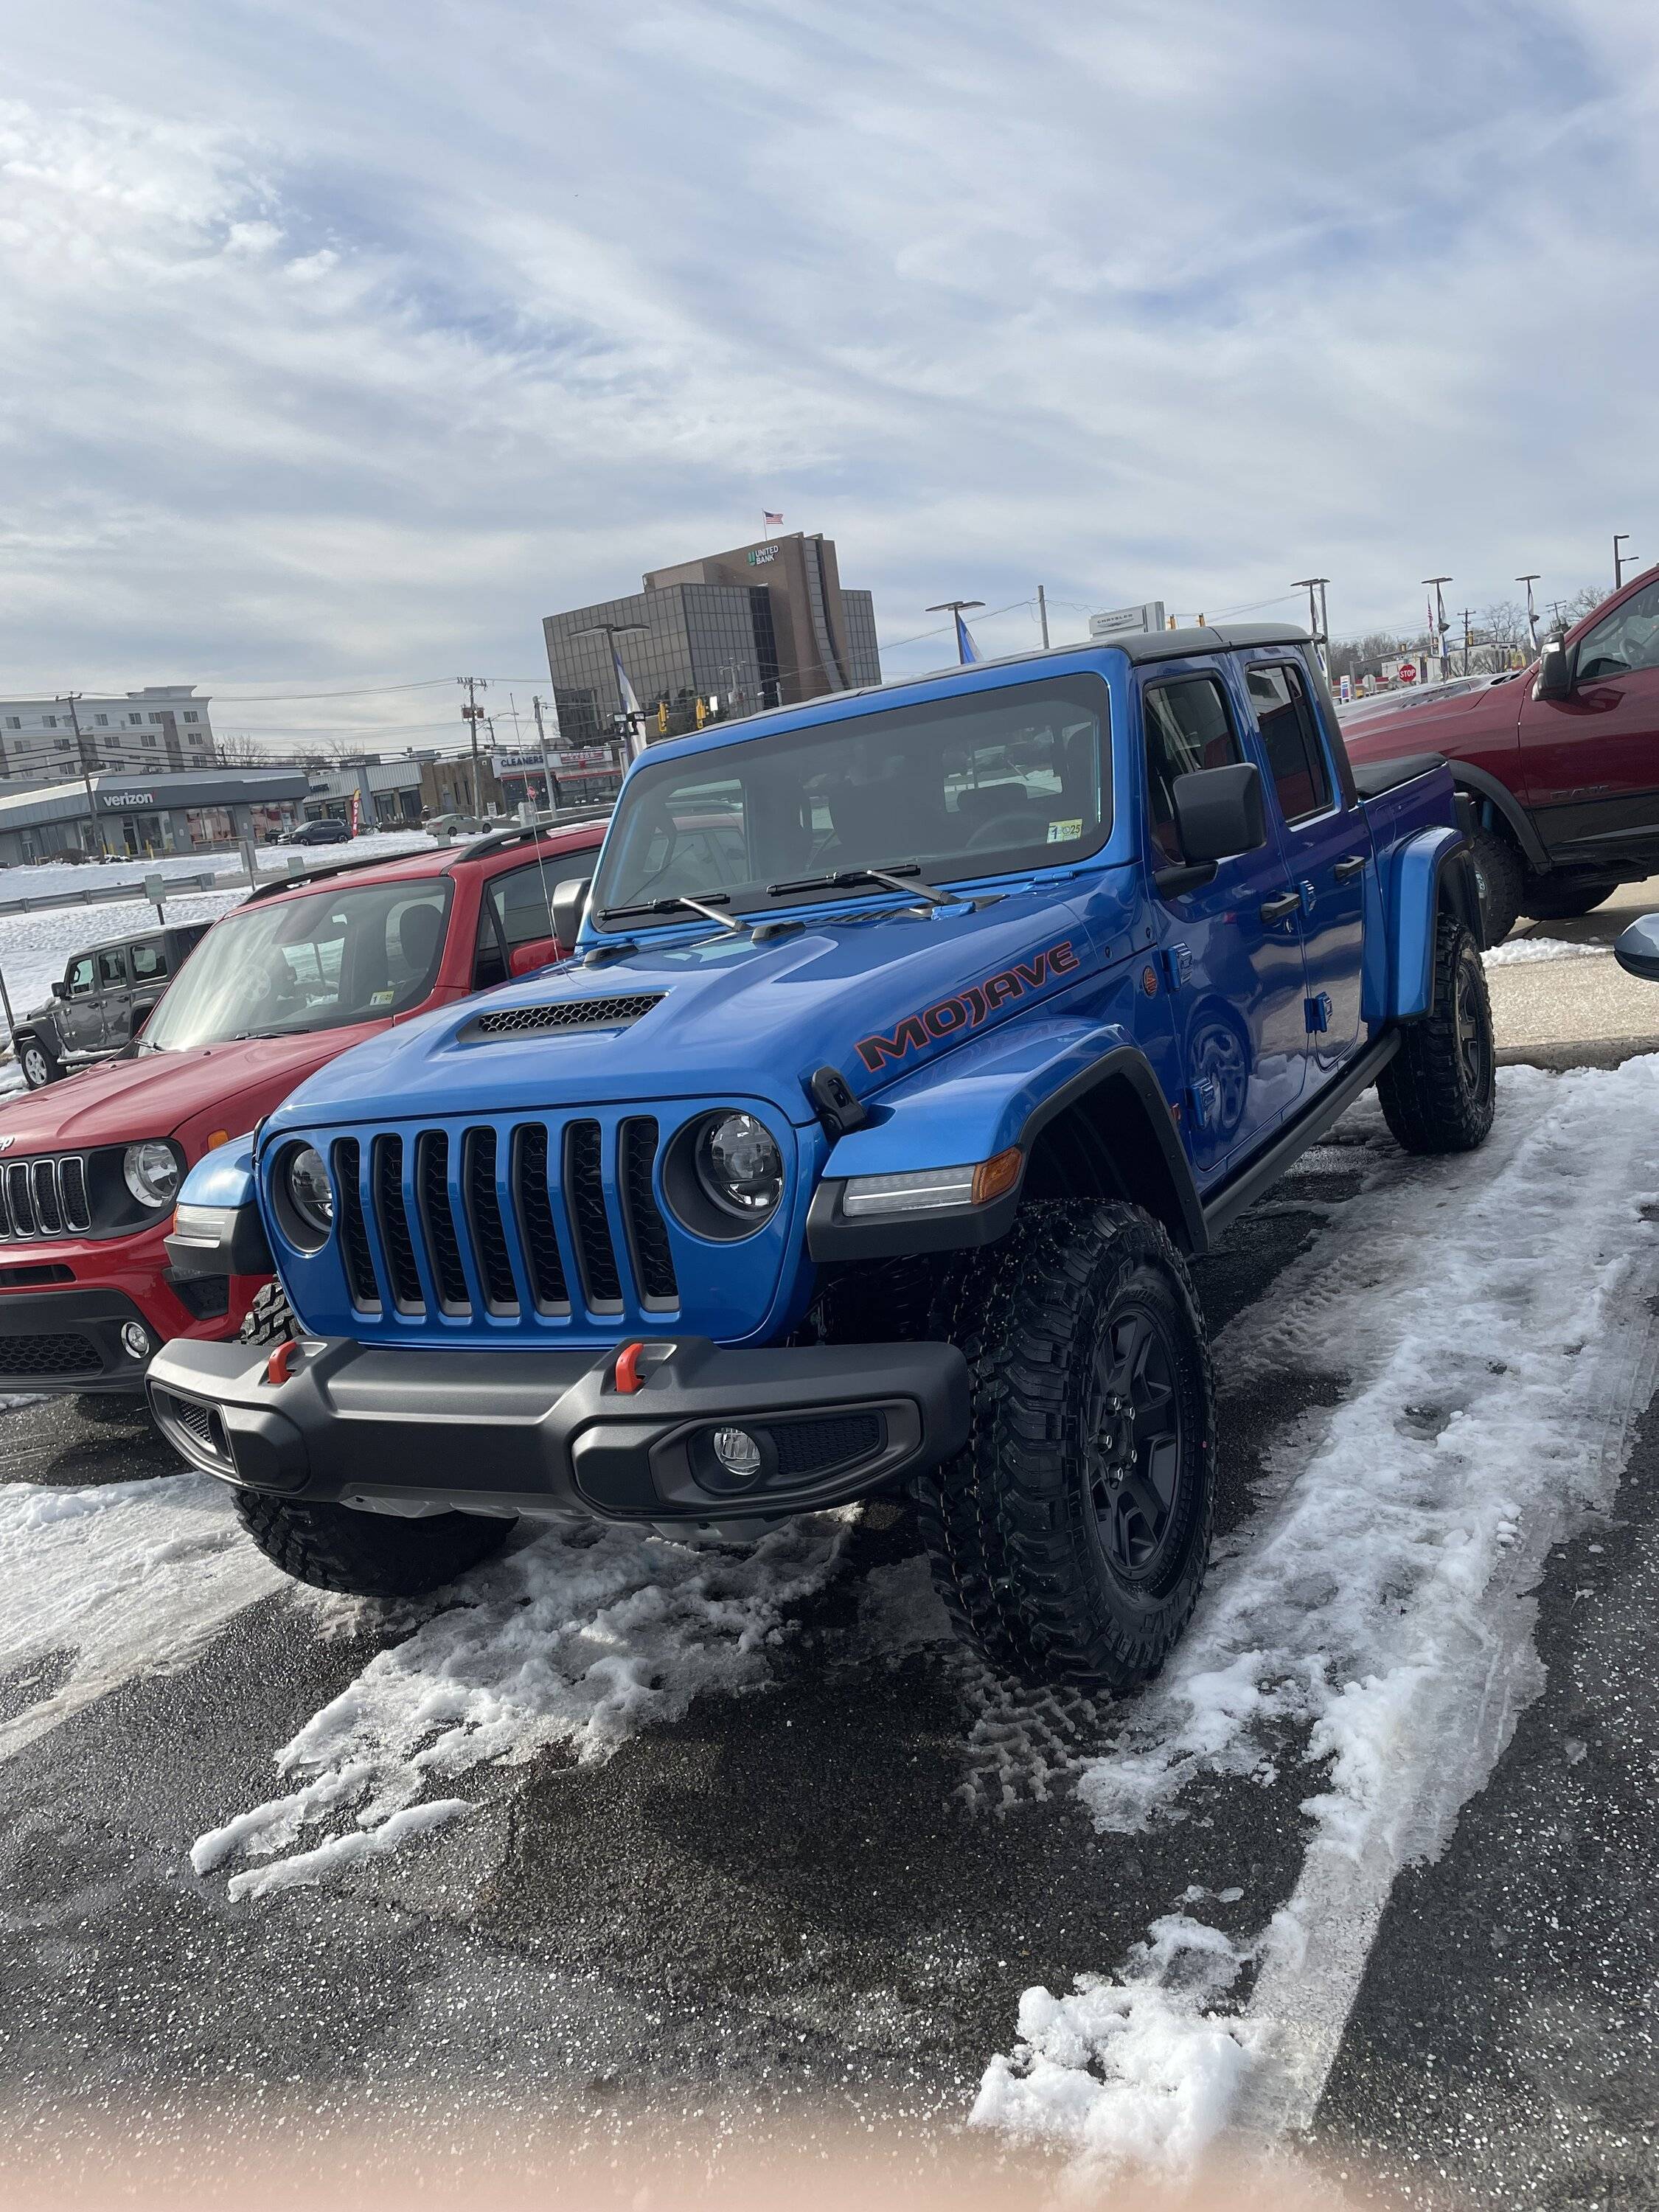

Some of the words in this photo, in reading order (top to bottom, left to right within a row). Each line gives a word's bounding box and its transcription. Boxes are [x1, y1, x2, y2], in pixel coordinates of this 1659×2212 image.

[755, 546, 779, 557] UNITED
[756, 554, 775, 565] BANK
[1097, 613, 1133, 624] CHRYSLER
[1399, 669, 1416, 678] STOP
[501, 755, 543, 768] CLEANERS
[103, 792, 153, 807] verizon
[1051, 826, 1058, 840] 1
[1070, 824, 1080, 834] 25
[854, 940, 1081, 1074] MOJAVE
